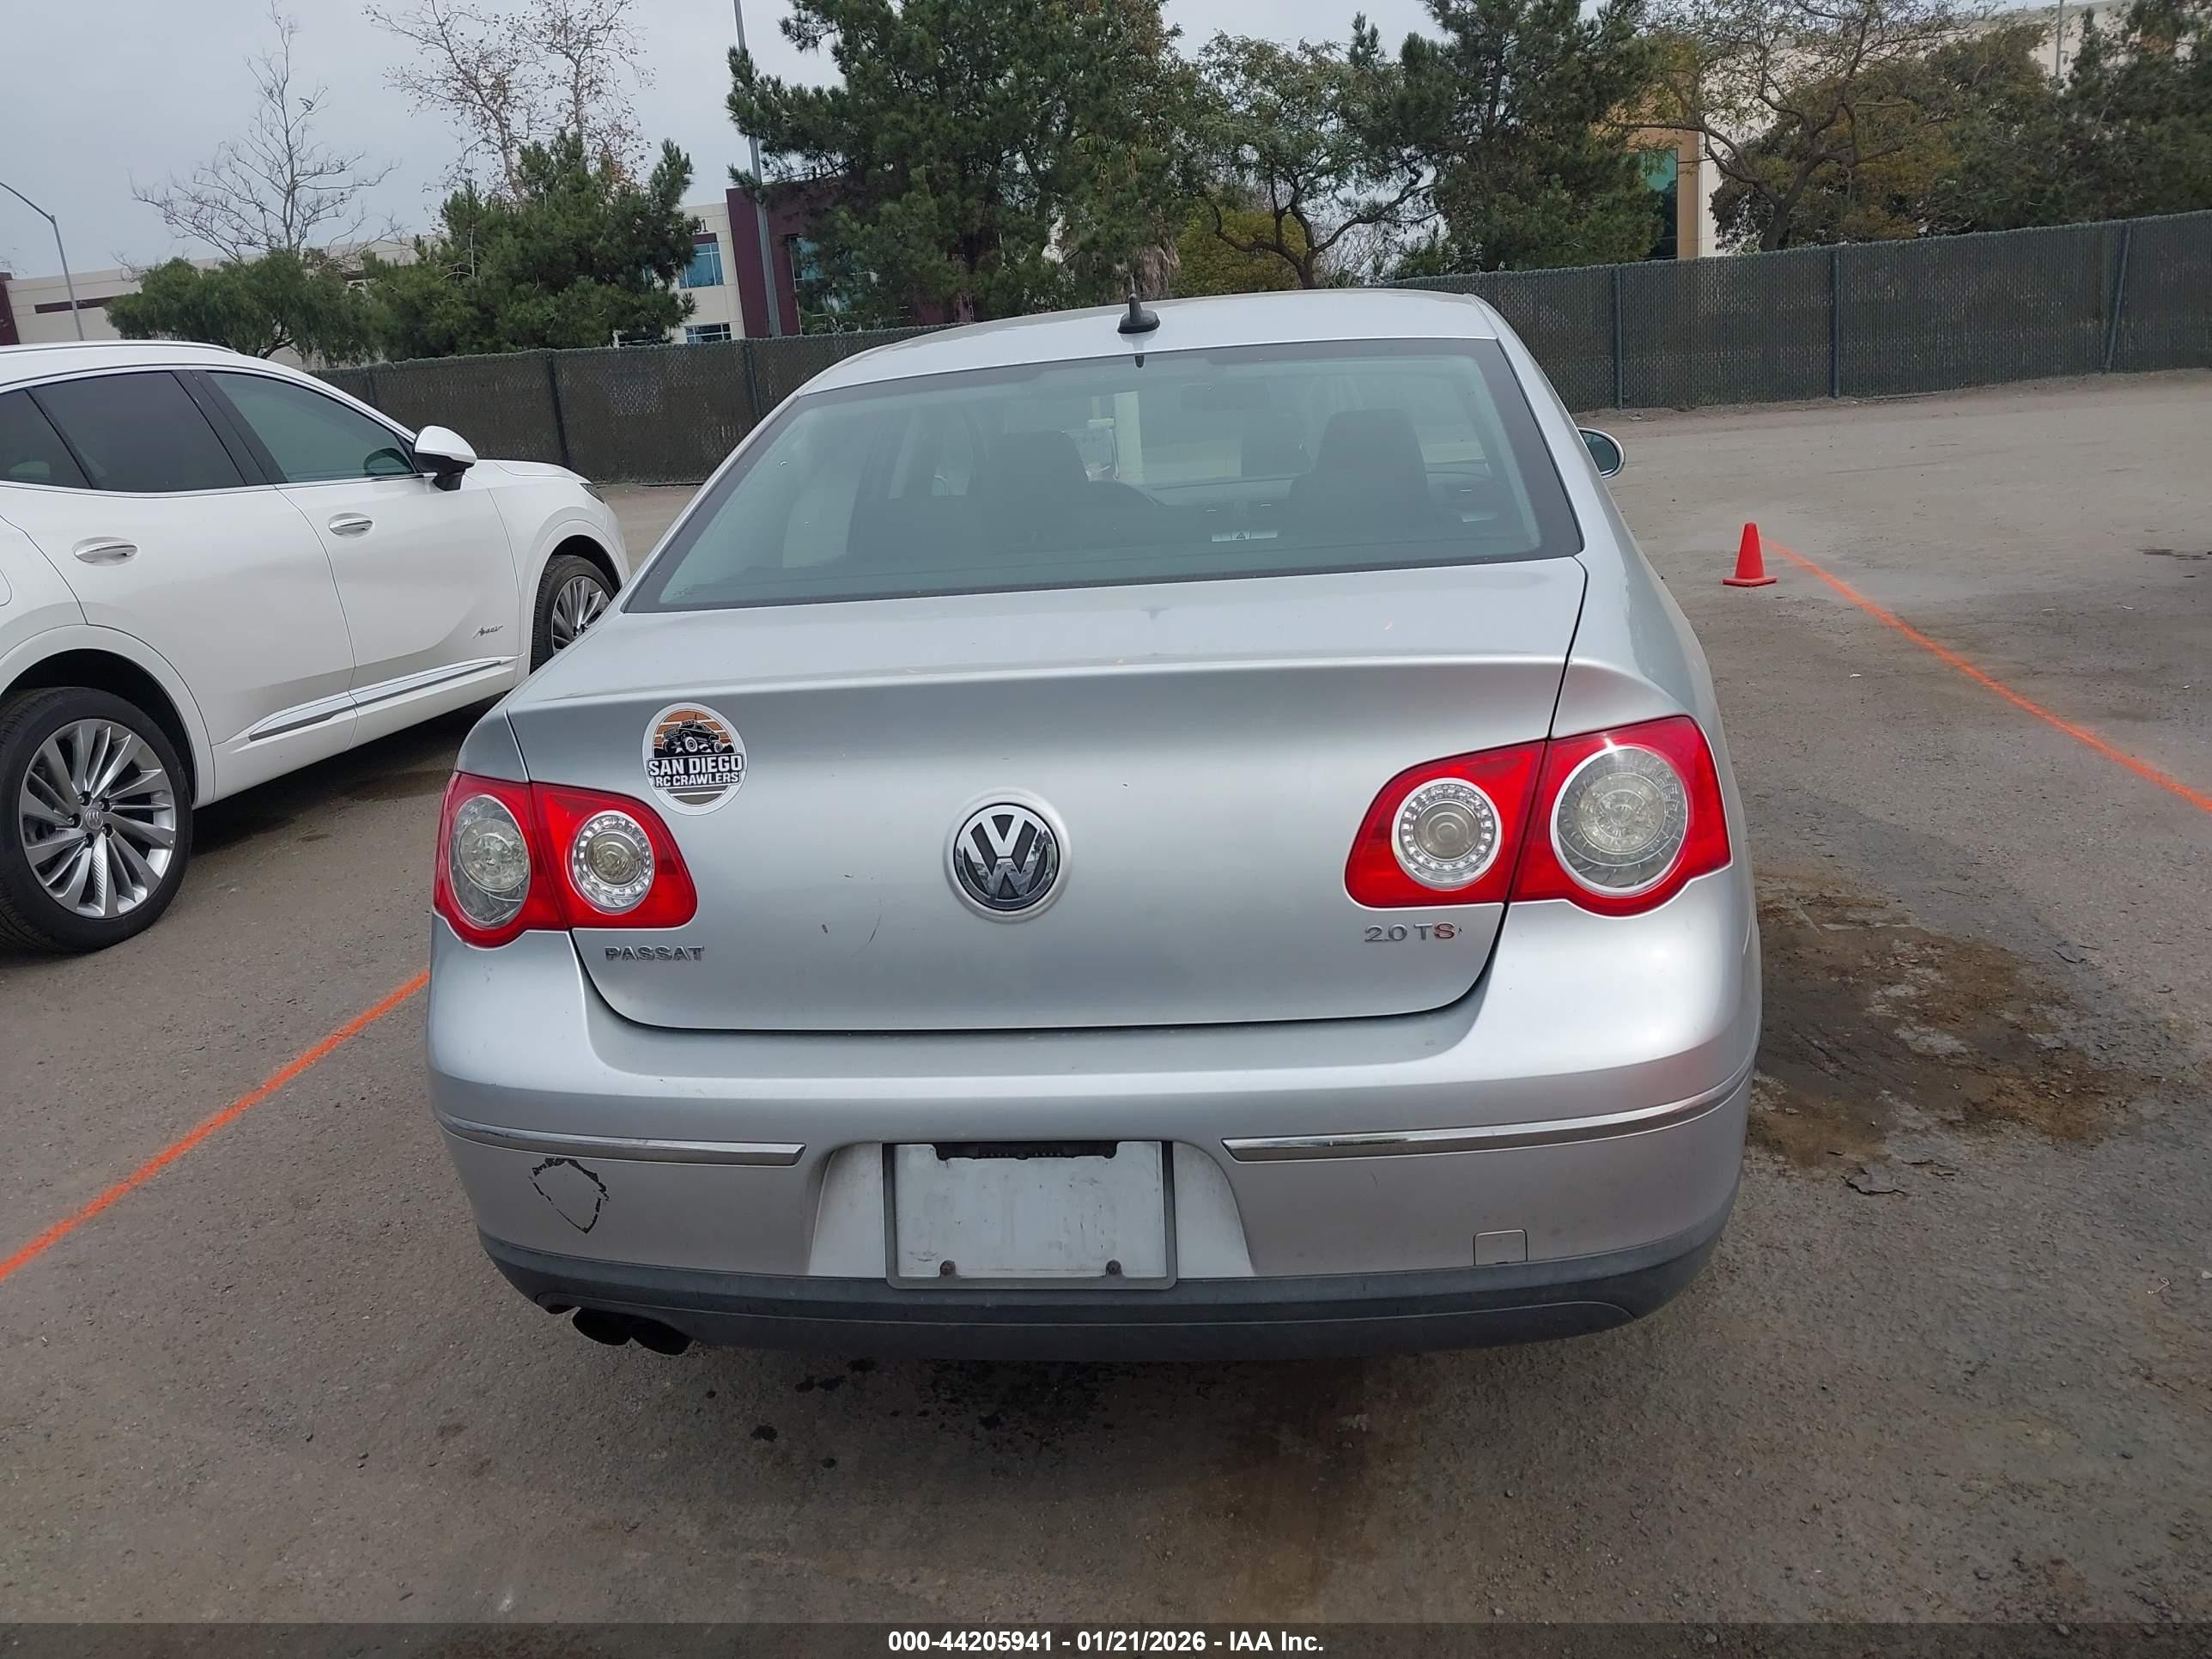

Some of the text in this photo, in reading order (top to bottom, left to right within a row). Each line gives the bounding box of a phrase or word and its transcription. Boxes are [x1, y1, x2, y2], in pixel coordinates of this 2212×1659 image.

[648, 756, 743, 776] SAN DIEGO
[655, 772, 738, 787] RC CRAWLERS
[604, 945, 705, 962] PASSAT
